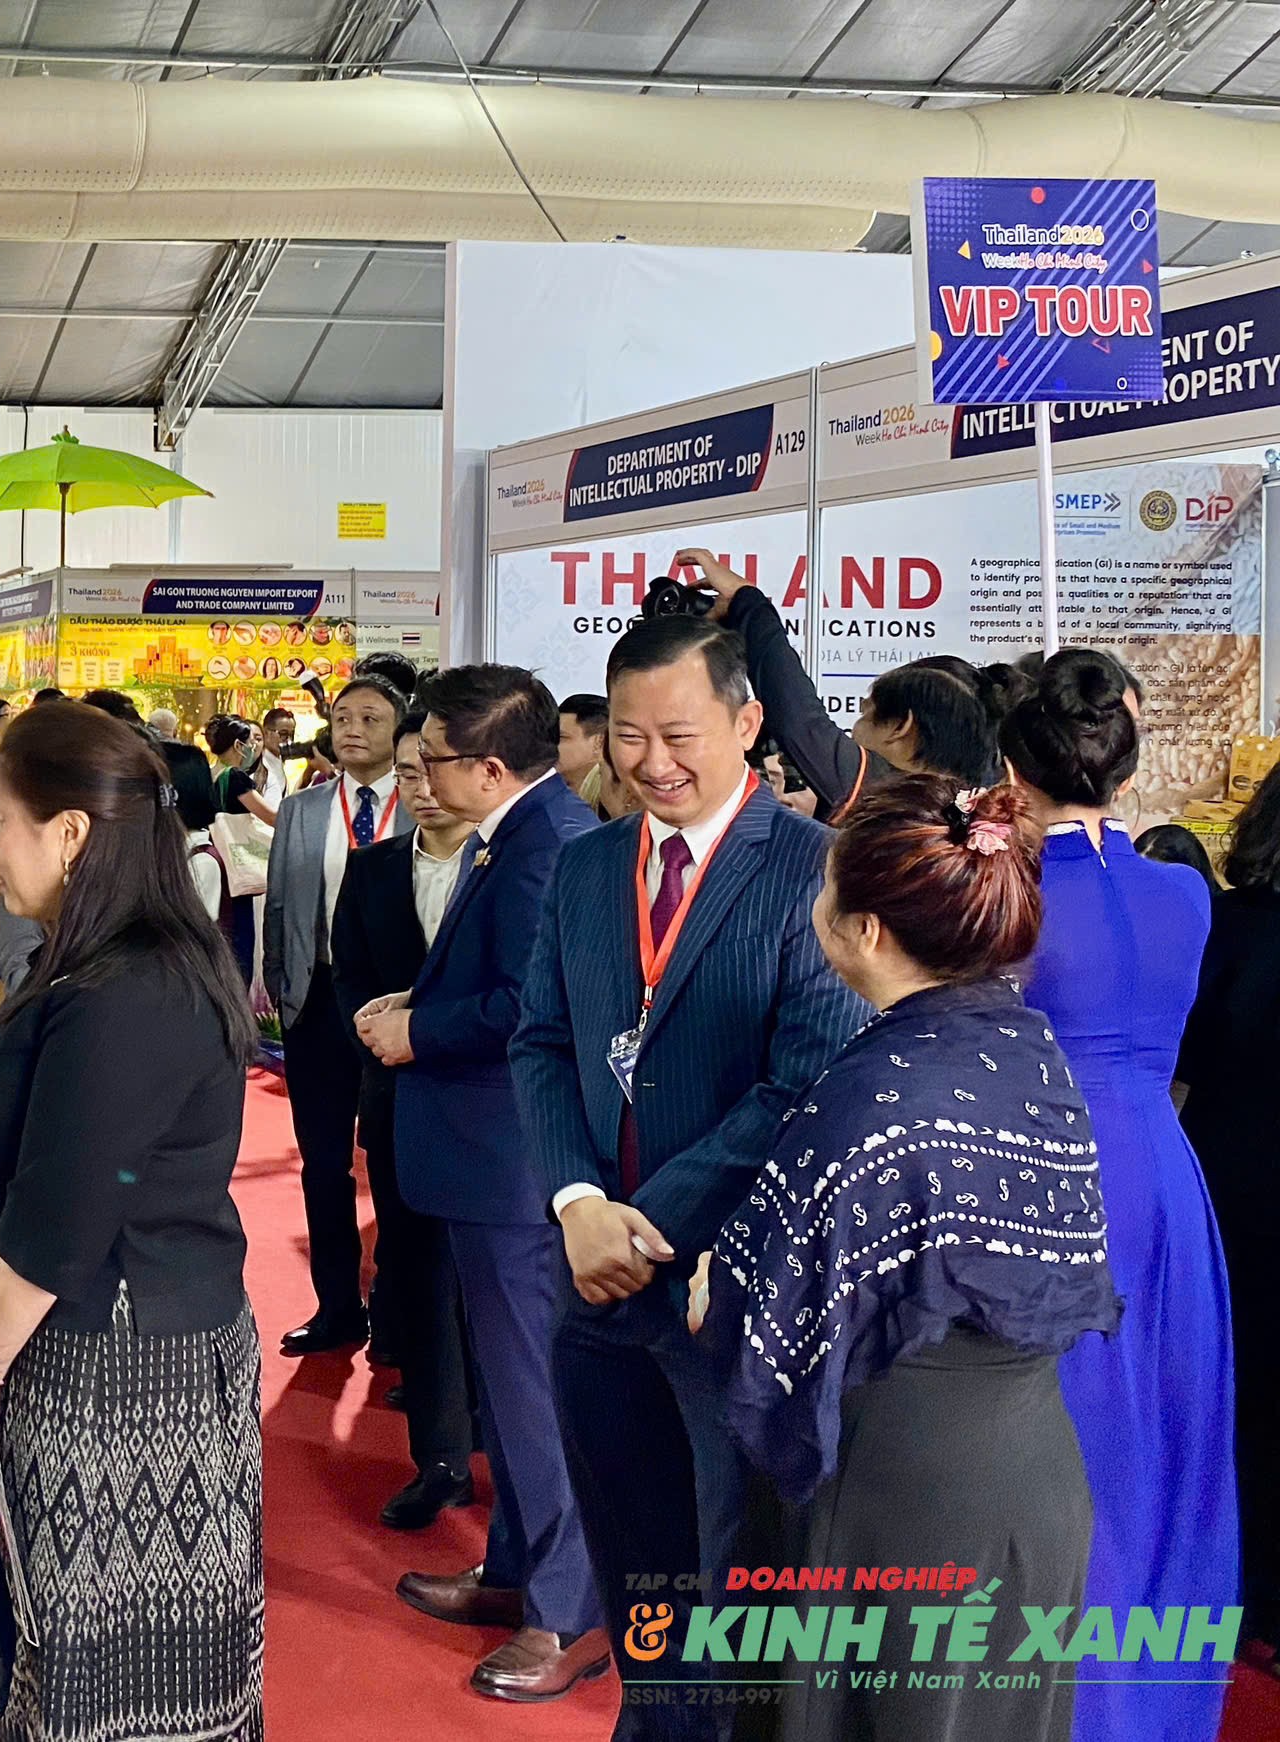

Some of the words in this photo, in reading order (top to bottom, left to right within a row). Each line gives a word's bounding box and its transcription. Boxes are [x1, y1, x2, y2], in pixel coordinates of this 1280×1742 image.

[939, 285, 1020, 337] VIP
[1025, 285, 1153, 336] TOUR
[1215, 320, 1255, 356] OF
[828, 409, 881, 436] Thailand
[882, 403, 915, 426] 2026
[963, 402, 1129, 439] INTELLCTUAL
[775, 429, 805, 457] A129
[855, 432, 881, 446] Week
[607, 442, 691, 476] DEPARTMENT
[694, 434, 713, 458] OF
[569, 475, 653, 508] INTELLECTUAL
[656, 458, 725, 491] PROPERTY
[736, 451, 762, 478] DIP
[1054, 494, 1102, 510] SMEP
[970, 558, 977, 566] A
[980, 558, 1040, 569] geographica
[1094, 559, 1112, 570] (GI)
[1114, 560, 1122, 568] is
[1174, 560, 1208, 572] symbol
[1210, 560, 1232, 570] used
[971, 574, 980, 582] to
[984, 573, 1020, 585] identify
[1024, 575, 1066, 585] prots
[1070, 575, 1089, 583] that
[1093, 575, 1117, 583] have
[1131, 575, 1167, 586] specific
[1170, 576, 1232, 587] geographical
[68, 588, 102, 596] Thailand
[153, 588, 166, 596] SAI
[167, 588, 185, 596] GON
[186, 588, 220, 597] TRUONG
[221, 588, 254, 597] NGUYEN
[255, 589, 286, 598] IMPORT
[287, 589, 318, 598] EXPORT
[325, 594, 345, 604] A111
[363, 590, 396, 598] Thailand
[970, 588, 997, 599] origin
[1002, 589, 1021, 597] and
[1069, 589, 1109, 599] qualities
[1139, 590, 1188, 600] reputation
[1192, 591, 1211, 599] that
[176, 600, 194, 609] AND
[194, 601, 221, 609] TRADE
[222, 601, 261, 610] COMPANY
[262, 602, 294, 610] LIMITED
[970, 603, 1022, 614] essentially
[1092, 605, 1101, 613] to
[1109, 606, 1128, 614] that
[970, 620, 1021, 630] represents
[1071, 620, 1080, 628] of
[1097, 620, 1119, 629] local
[1124, 621, 1181, 632] community,
[1186, 621, 1232, 632] signifying
[970, 634, 985, 643] the
[1070, 635, 1088, 643] and
[1090, 635, 1115, 645] place
[1117, 636, 1127, 644] of
